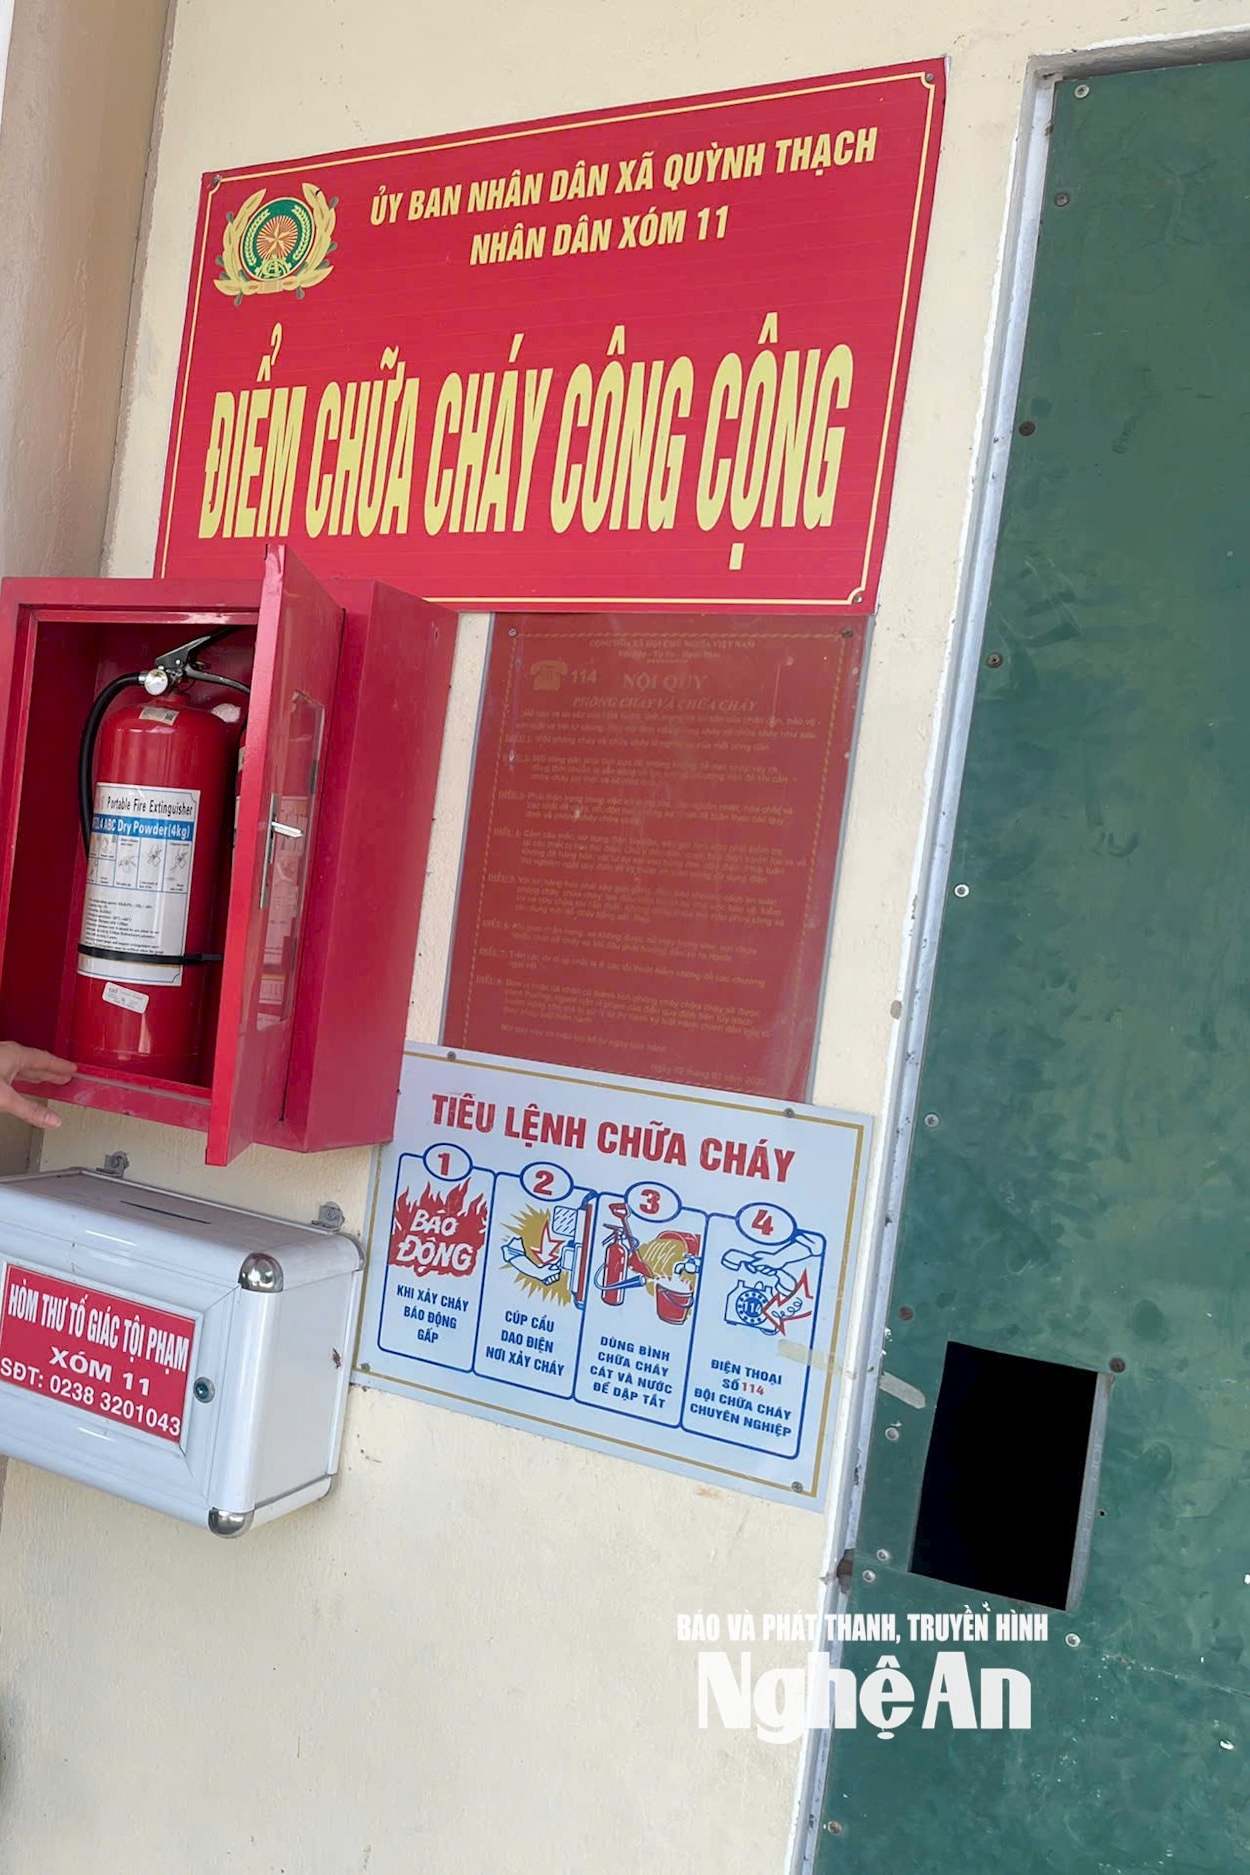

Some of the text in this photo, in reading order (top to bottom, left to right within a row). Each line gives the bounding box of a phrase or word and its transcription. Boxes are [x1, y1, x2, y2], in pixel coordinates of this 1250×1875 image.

[369, 126, 879, 226] ỦY BAN NHÂN DÂN XÃ QUỲNH THẠCH
[470, 204, 729, 266] NHÂN DÂN XÓM 11
[198, 312, 854, 571] ĐIỂM CHỮA CHÁY CÔNG CỘNG
[570, 669, 598, 684] 114
[622, 671, 657, 693] NỘI
[107, 796, 193, 817] Portable Fire Extinguisher
[117, 819, 131, 835] Dry
[504, 1103, 587, 1149] LỆNH
[596, 1119, 689, 1168] CHỮA
[699, 1138, 797, 1184] CHÁY
[436, 1152, 452, 1175] 1
[532, 1170, 555, 1196] 2
[638, 1189, 662, 1215] 3
[750, 1208, 774, 1236] 4
[396, 1234, 474, 1273] ĐỘNG
[397, 1284, 469, 1312] KHI XẢY CHÁY
[8, 1279, 190, 1375] HÒM THƯ TỐ GIÁC TỘI PHẠM
[403, 1305, 457, 1329] BÁO ĐỘNG
[505, 1309, 528, 1326] CÚP
[417, 1326, 439, 1344] GẤP
[501, 1329, 554, 1353] DAO ĐIỆN
[486, 1346, 565, 1377] NƠI XẢY CHÁY
[600, 1336, 670, 1362] DÙNG BÌNH
[50, 1346, 150, 1396] XÓM 11
[597, 1350, 670, 1378] CHỮA CHÁY
[710, 1359, 782, 1385] ĐIỆN THOẠI
[590, 1365, 673, 1395] CÁT VÀ NƯỚC
[722, 1378, 765, 1396] SỐ 114
[0, 1357, 182, 1437] SĐT: 0238 3201043
[613, 1387, 638, 1401] DẬP
[694, 1388, 792, 1421] ĐỘI CHỮA CHÁY
[690, 1403, 792, 1438] CHUYÊN NGHIỆP
